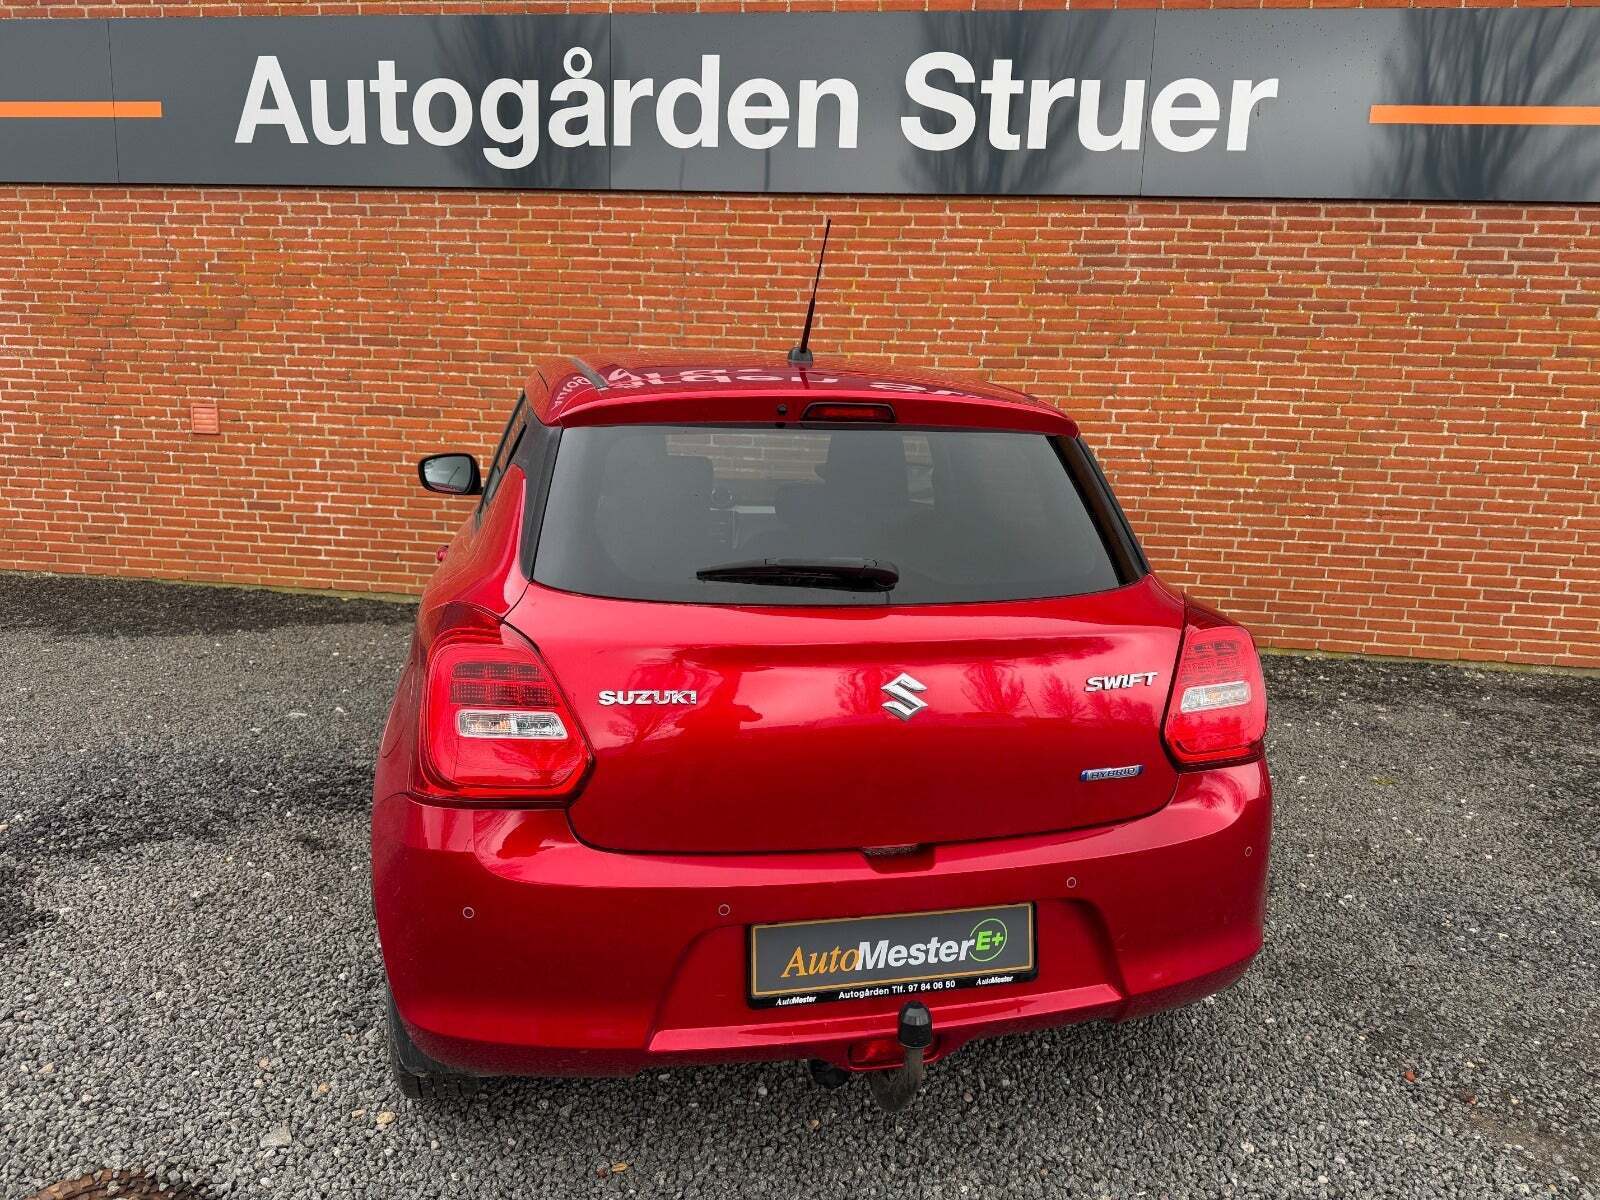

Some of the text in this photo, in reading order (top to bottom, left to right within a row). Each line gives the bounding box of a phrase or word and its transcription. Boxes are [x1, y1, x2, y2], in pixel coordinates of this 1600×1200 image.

[234, 46, 1279, 170] Autogården Struer
[1084, 671, 1158, 692] SWIFT
[598, 690, 697, 706] SUZUKI
[1090, 767, 1136, 779] HYBRID
[781, 937, 975, 977] AutoMester
[976, 976, 1014, 986] AutoMester
[838, 986, 889, 999] Autogården
[892, 985, 906, 994] Tlf.
[908, 984, 918, 992] 97
[920, 982, 931, 991] 84
[776, 995, 817, 1006] AutoMester
